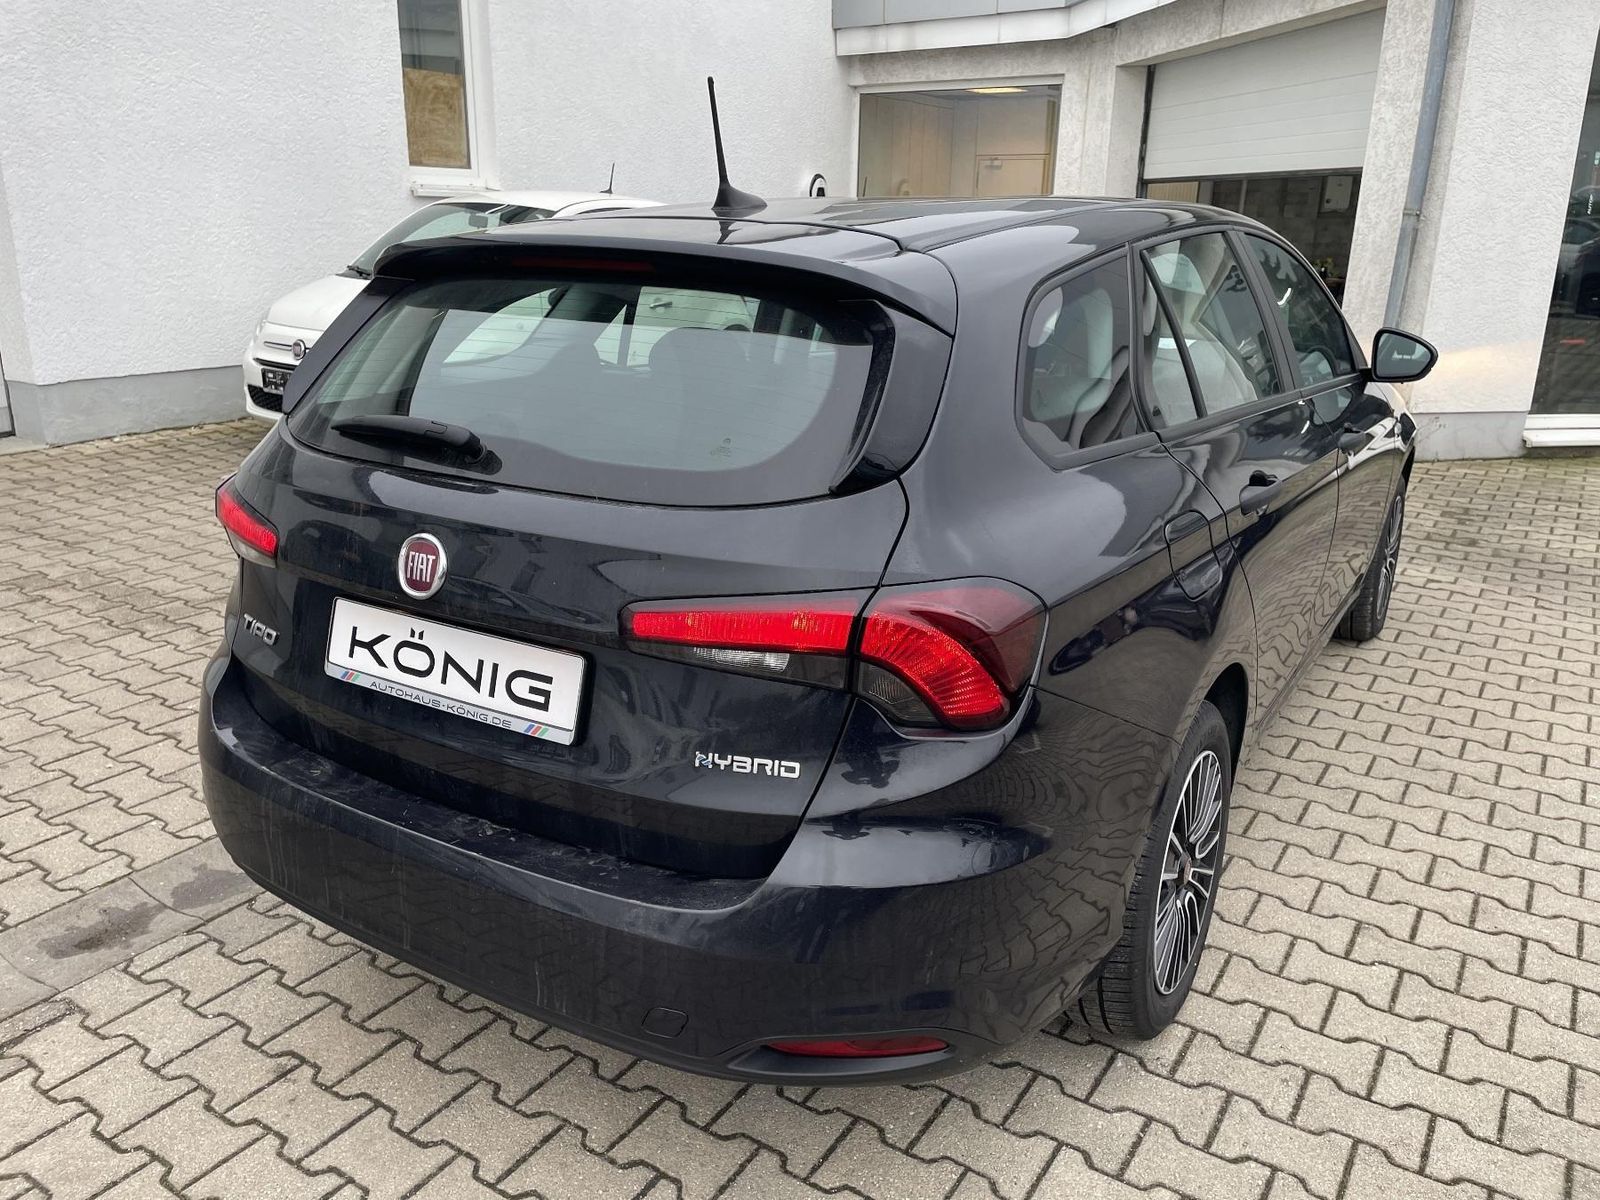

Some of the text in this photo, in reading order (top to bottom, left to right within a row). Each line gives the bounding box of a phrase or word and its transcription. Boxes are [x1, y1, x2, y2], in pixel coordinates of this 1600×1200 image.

[406, 551, 436, 583] FIAT
[243, 613, 278, 646] TIPO
[348, 626, 554, 712] KÖNIG
[694, 751, 801, 779] HYBRID
